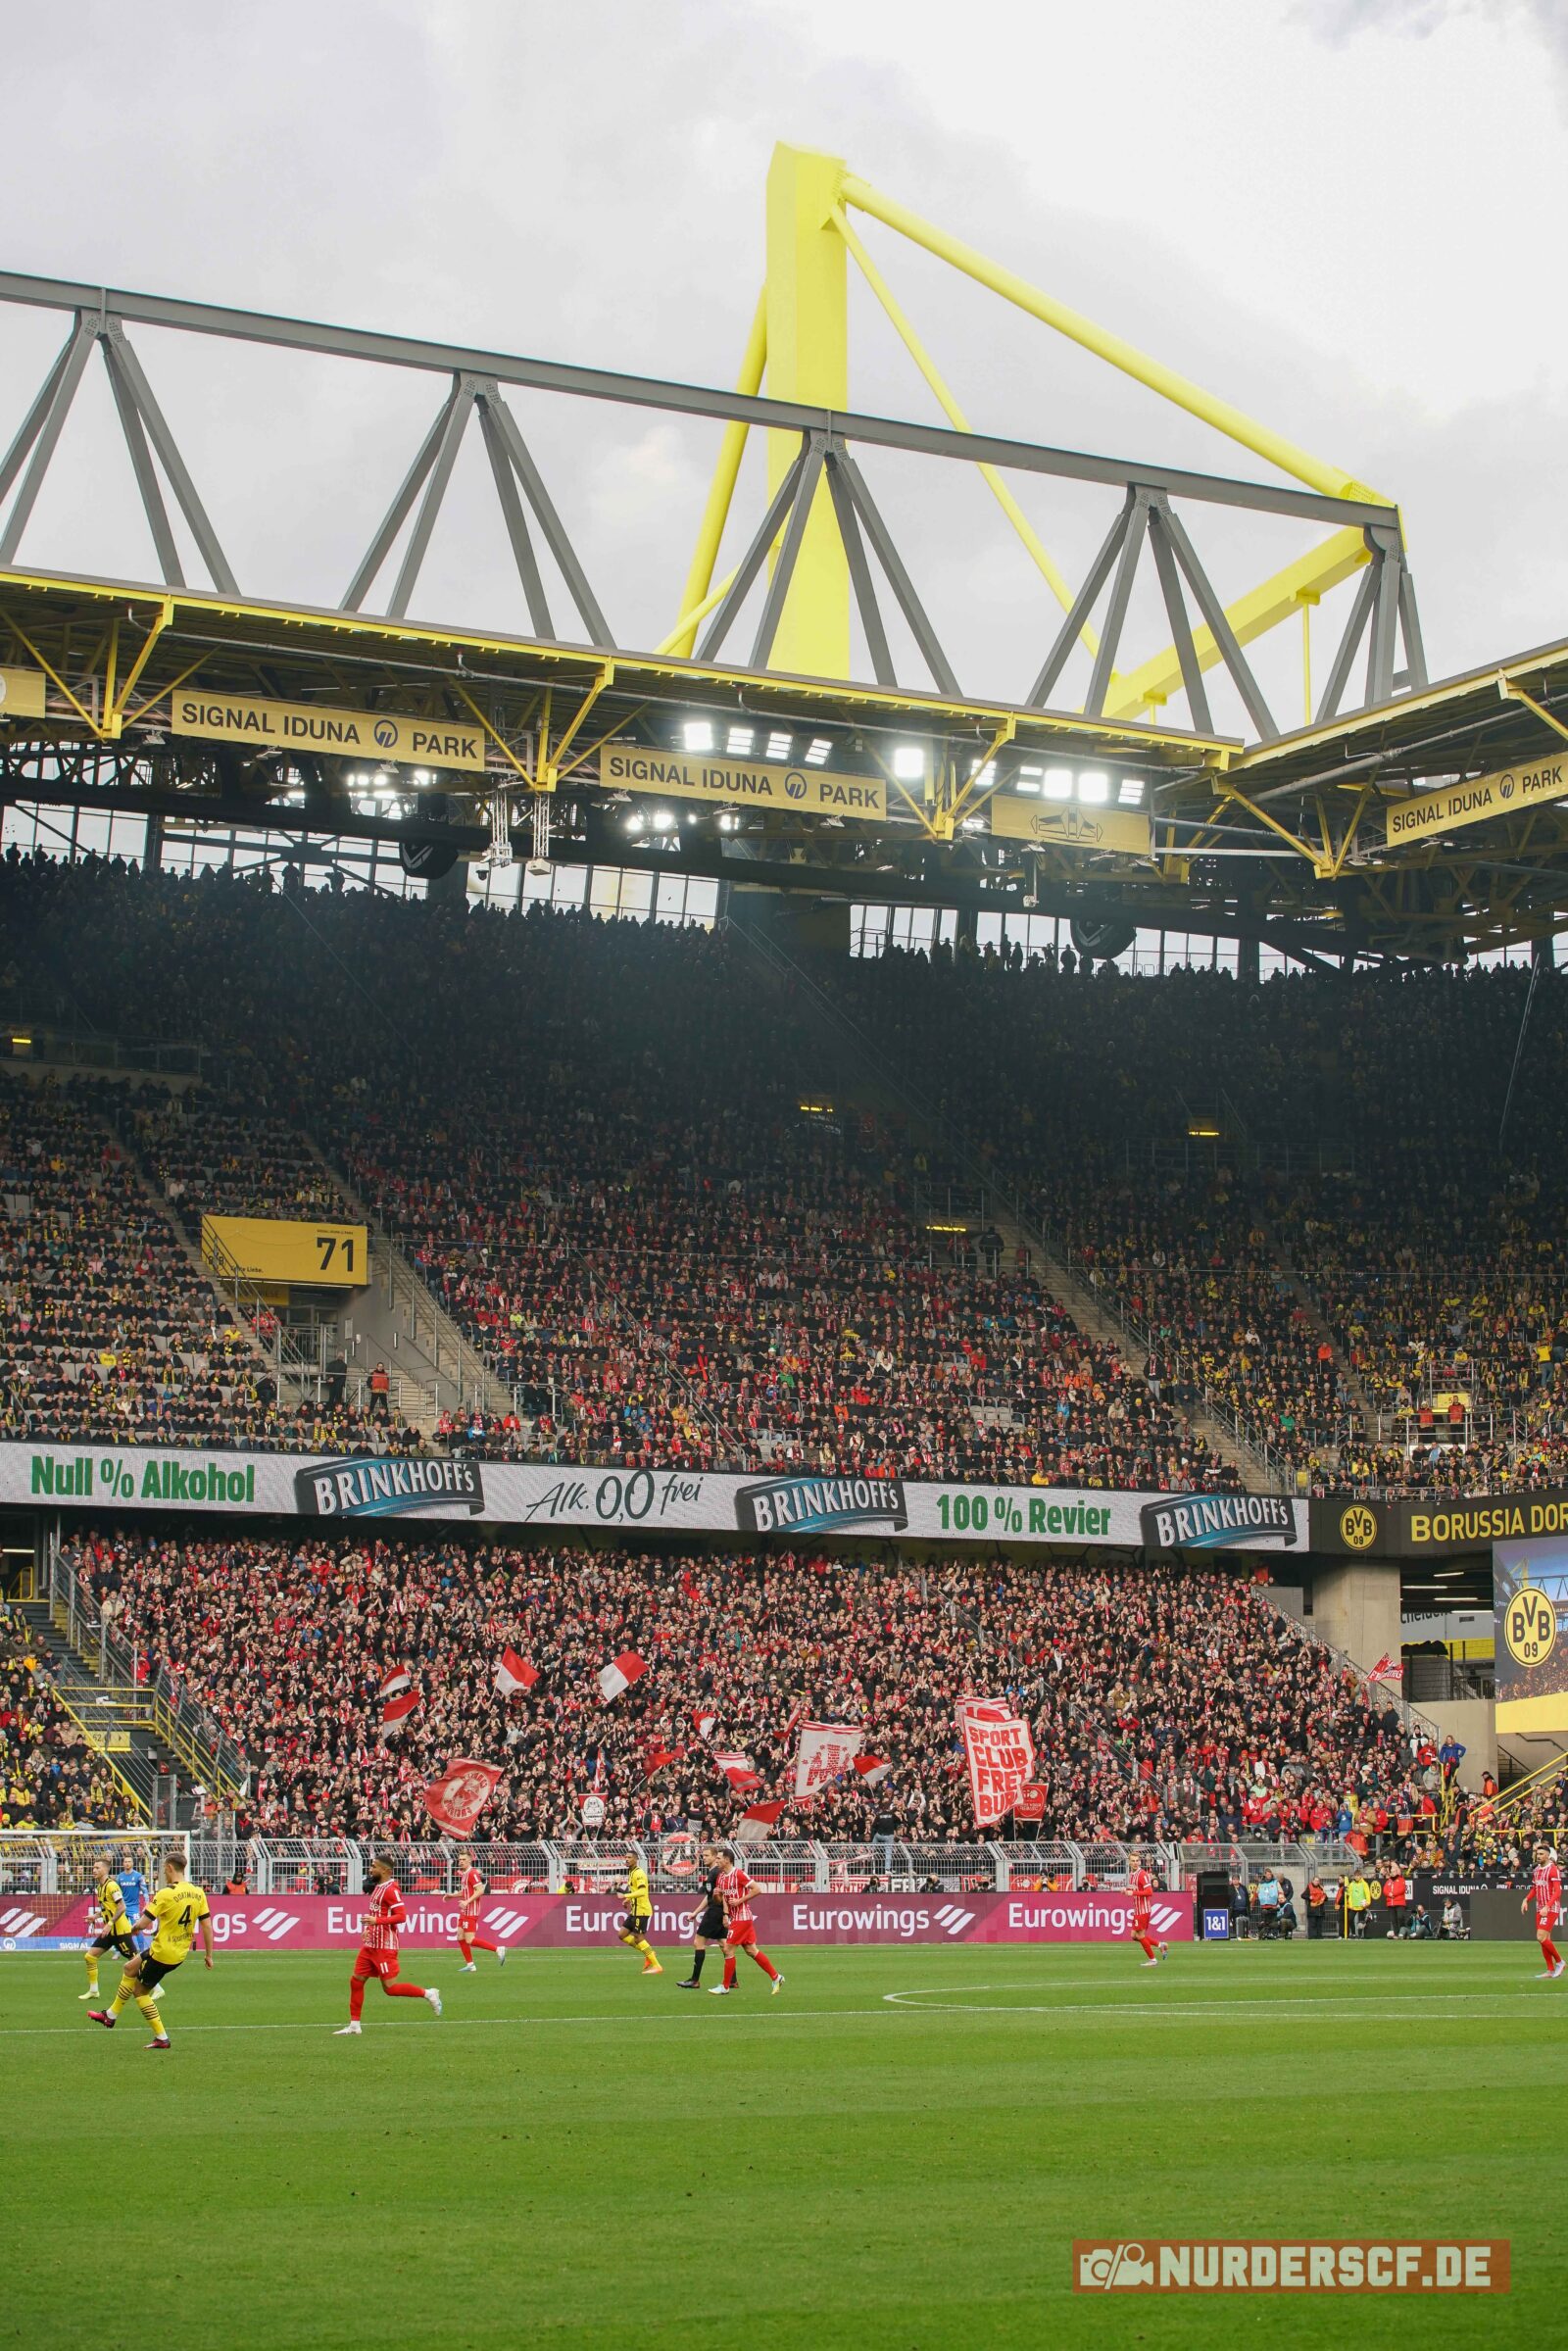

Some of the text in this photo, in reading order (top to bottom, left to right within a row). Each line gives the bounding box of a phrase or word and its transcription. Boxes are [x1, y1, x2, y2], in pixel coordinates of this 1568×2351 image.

[181, 702, 478, 759] SIGNAL IDUNA PARK
[609, 757, 880, 809] SIGNAL IDUNA PARK
[1393, 765, 1563, 833] SIGNAL IDUNA PARK
[317, 1237, 354, 1272] 71
[31, 1455, 255, 1502] Null % Alkohol
[524, 1470, 704, 1523] Alk. 0,0 frei
[936, 1493, 1111, 1536] 100 % Revier
[1345, 1510, 1373, 1537] BVB
[1411, 1501, 1568, 1542] BORUSSIA DOR
[1353, 1535, 1364, 1545] 09
[1512, 1595, 1550, 1643] BVB
[1524, 1641, 1539, 1658] 09
[968, 1726, 1021, 1746] SPORT
[972, 1745, 1028, 1769] CLUB
[173, 1892, 202, 1903] DORTMUND
[1433, 1886, 1480, 1895] SIGNAL IDU
[177, 1905, 192, 1928] 4
[565, 1905, 706, 1939] Euroing
[793, 1903, 929, 1936] Eurowings
[1008, 1902, 1135, 1935] Eurowings
[1205, 1916, 1226, 1931] 1&1
[60, 1941, 91, 1950] SIGNAL
[119, 1941, 128, 1952] 11
[379, 1961, 389, 1974] 11
